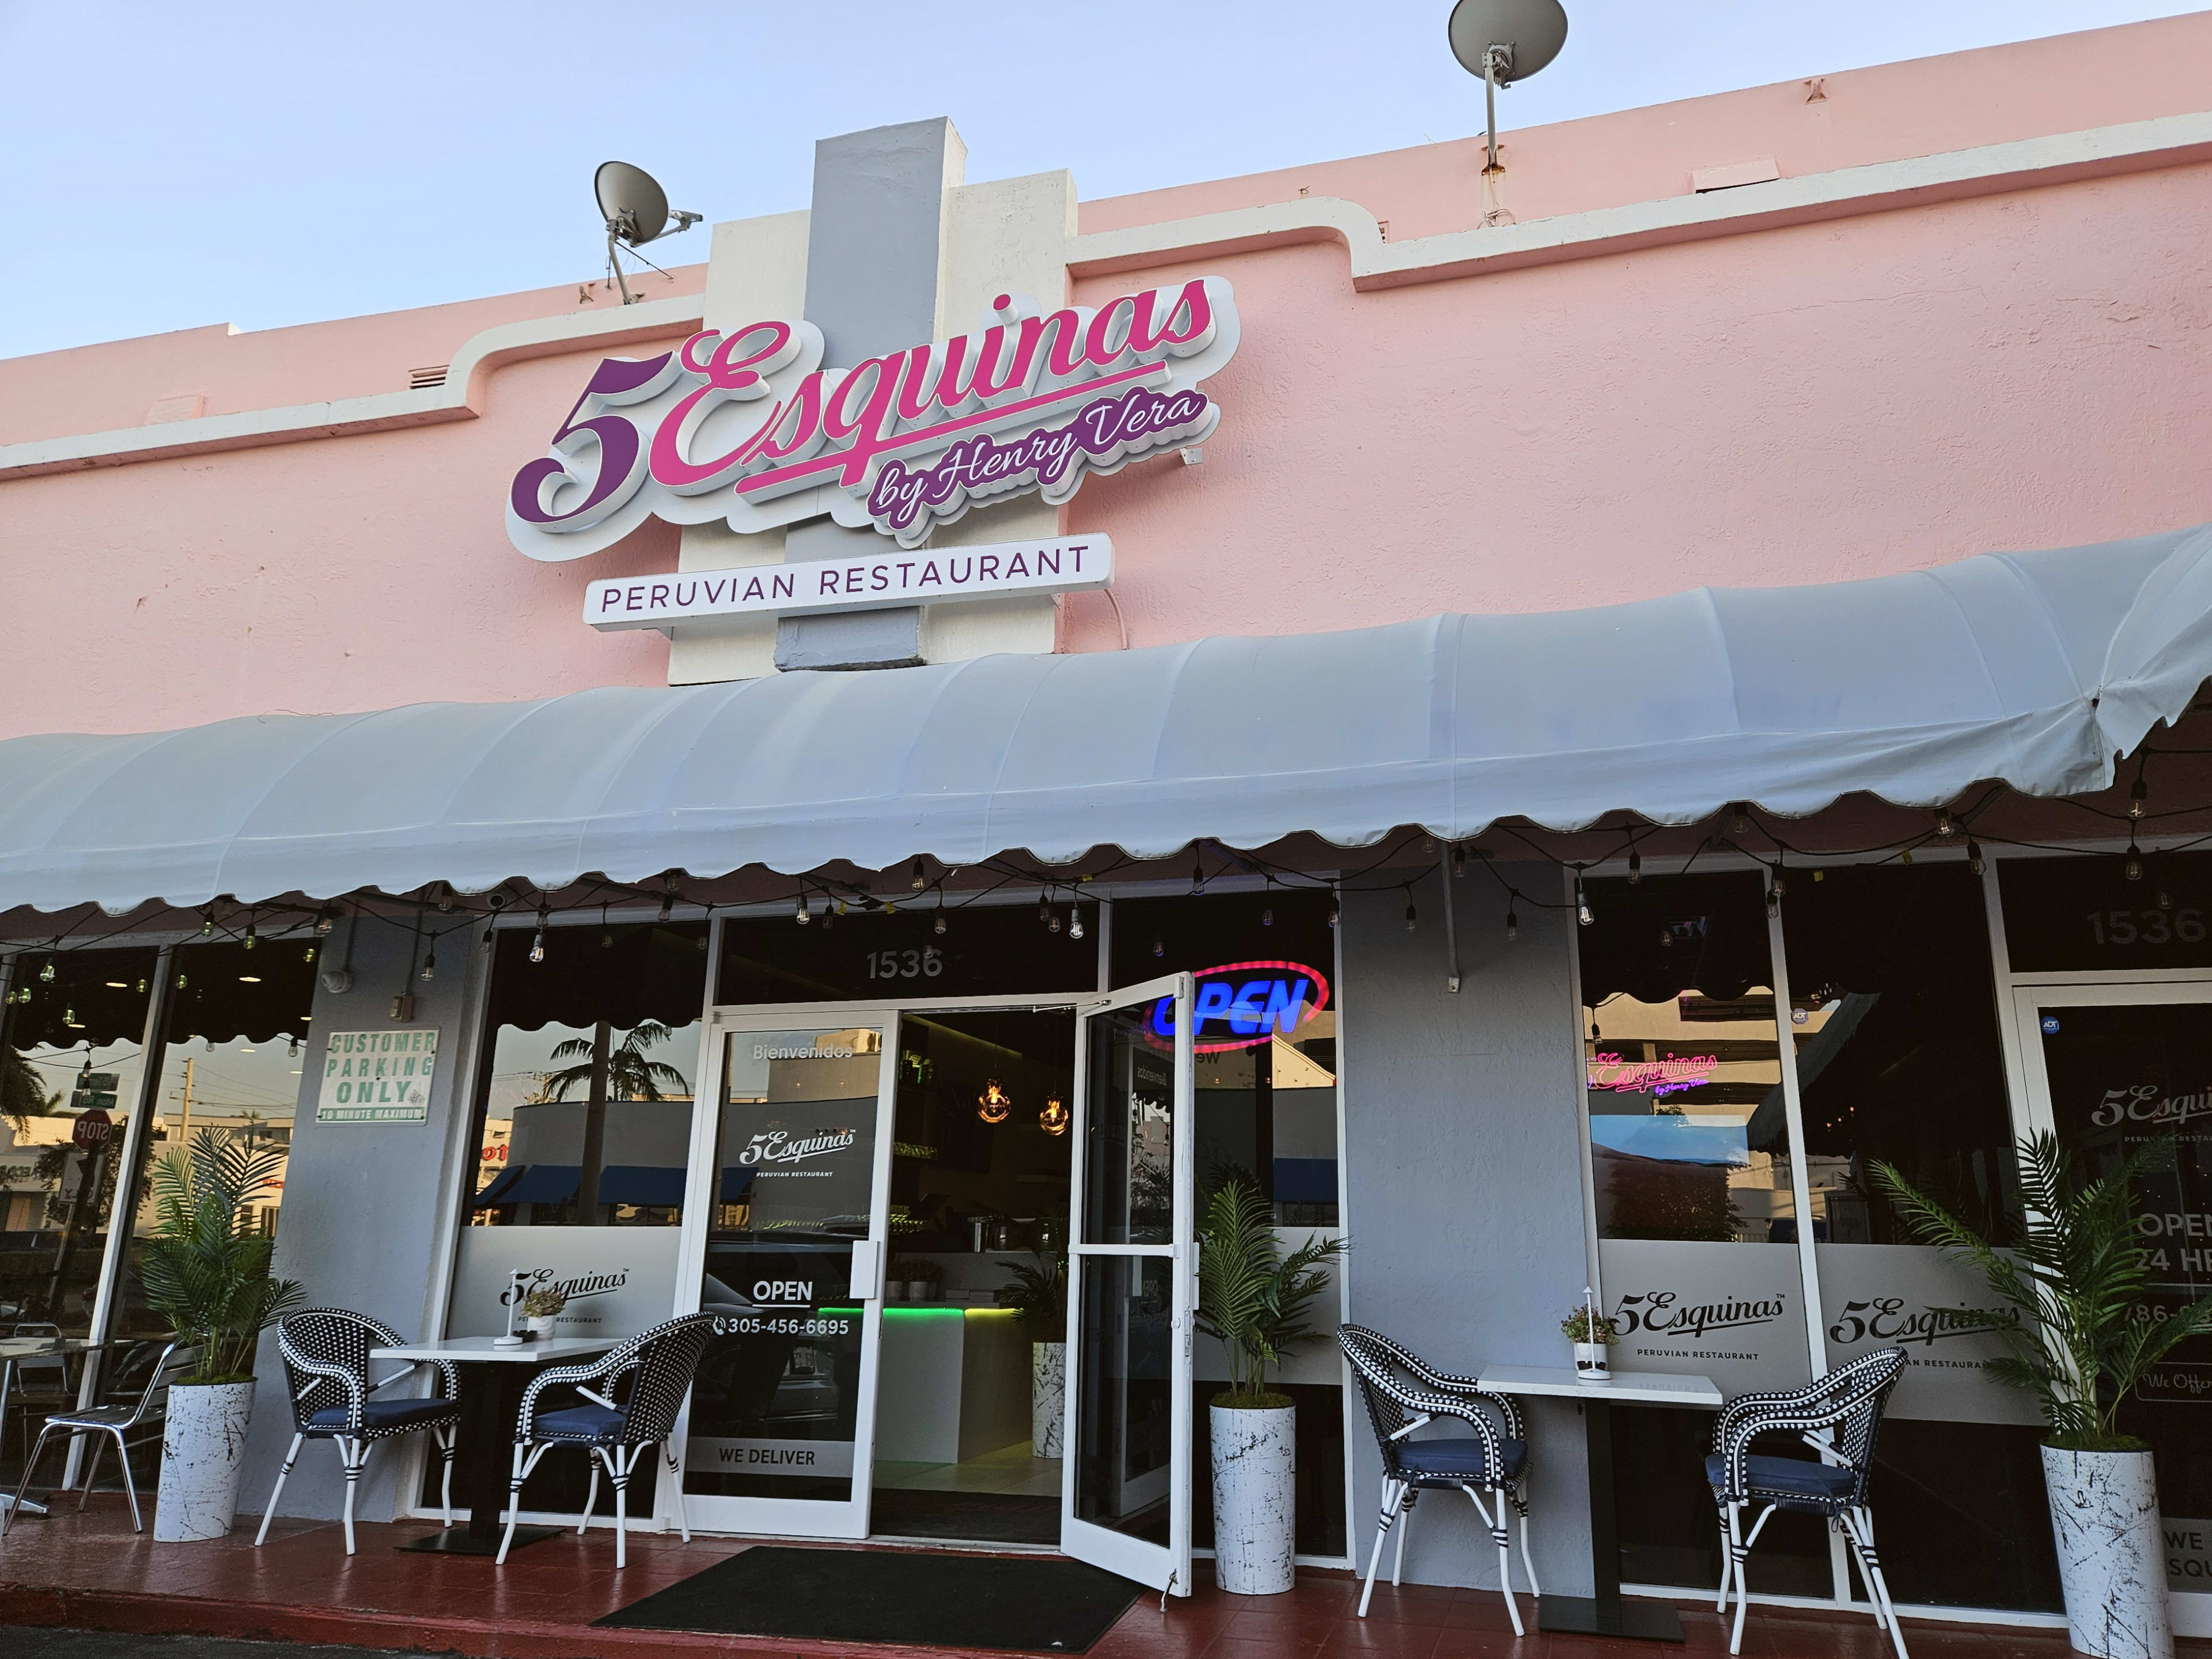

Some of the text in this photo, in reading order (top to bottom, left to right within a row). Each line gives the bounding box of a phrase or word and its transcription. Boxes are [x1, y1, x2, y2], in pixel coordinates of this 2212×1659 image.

[876, 397, 1202, 522] by Henry Vera
[601, 545, 1089, 613] PERUVIAN RESTAURANT
[2086, 907, 2207, 945] 1536
[867, 949, 943, 979] 1536
[330, 1032, 435, 1054] CUSTOMER
[753, 1043, 853, 1060] Bienvenidos
[325, 1056, 433, 1077] PARKING
[336, 1081, 412, 1104] ONLY
[321, 1109, 422, 1120] 10 MINUTE MAXIMUM
[753, 1281, 813, 1300] OPEN
[728, 1318, 849, 1335] 305-456-6695
[1637, 1349, 1759, 1361] PERUVIAN RESTAURANT
[719, 1448, 815, 1465] WE DELIVER
[2162, 1531, 2203, 1550] WE
